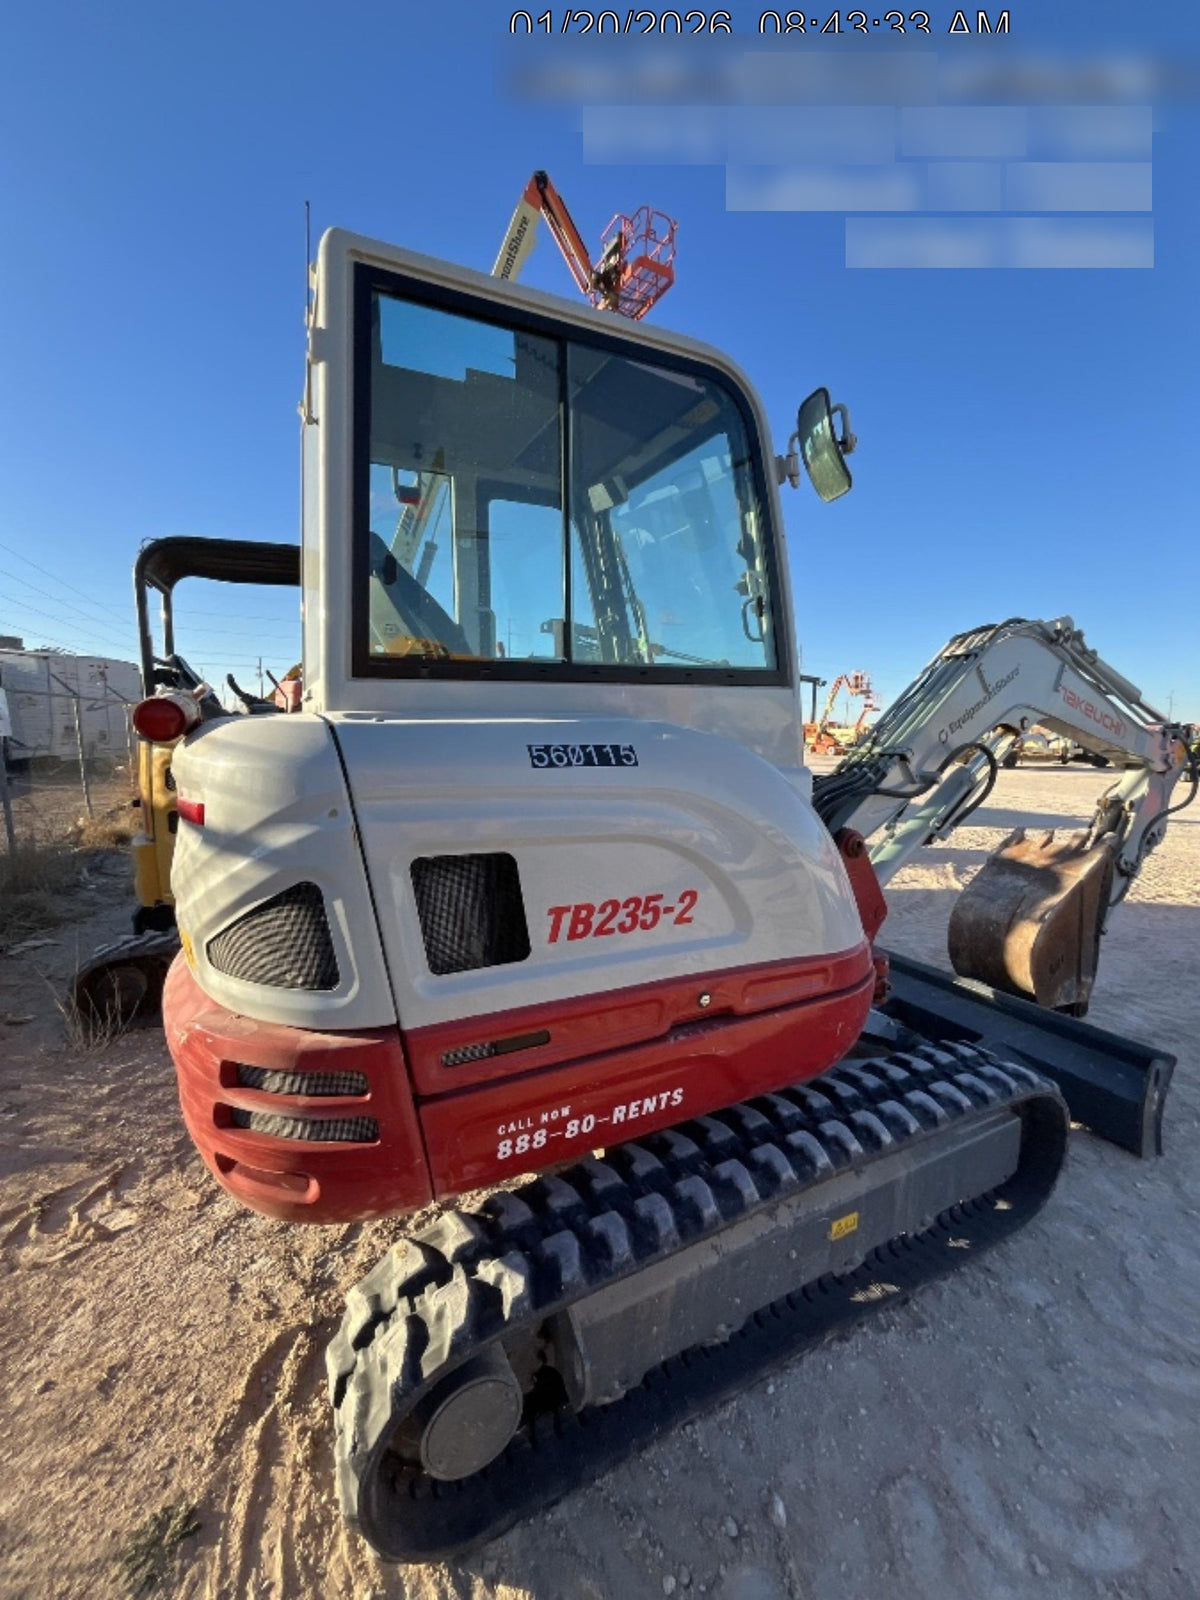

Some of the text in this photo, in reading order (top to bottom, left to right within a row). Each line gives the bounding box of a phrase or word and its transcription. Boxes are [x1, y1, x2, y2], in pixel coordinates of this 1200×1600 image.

[949, 667, 1020, 734] EquipmentShare
[531, 746, 636, 767] 560115
[547, 890, 698, 944] TB235-2
[497, 1105, 571, 1135] CALL NOW
[497, 1088, 684, 1159] 888-80-RENTS
